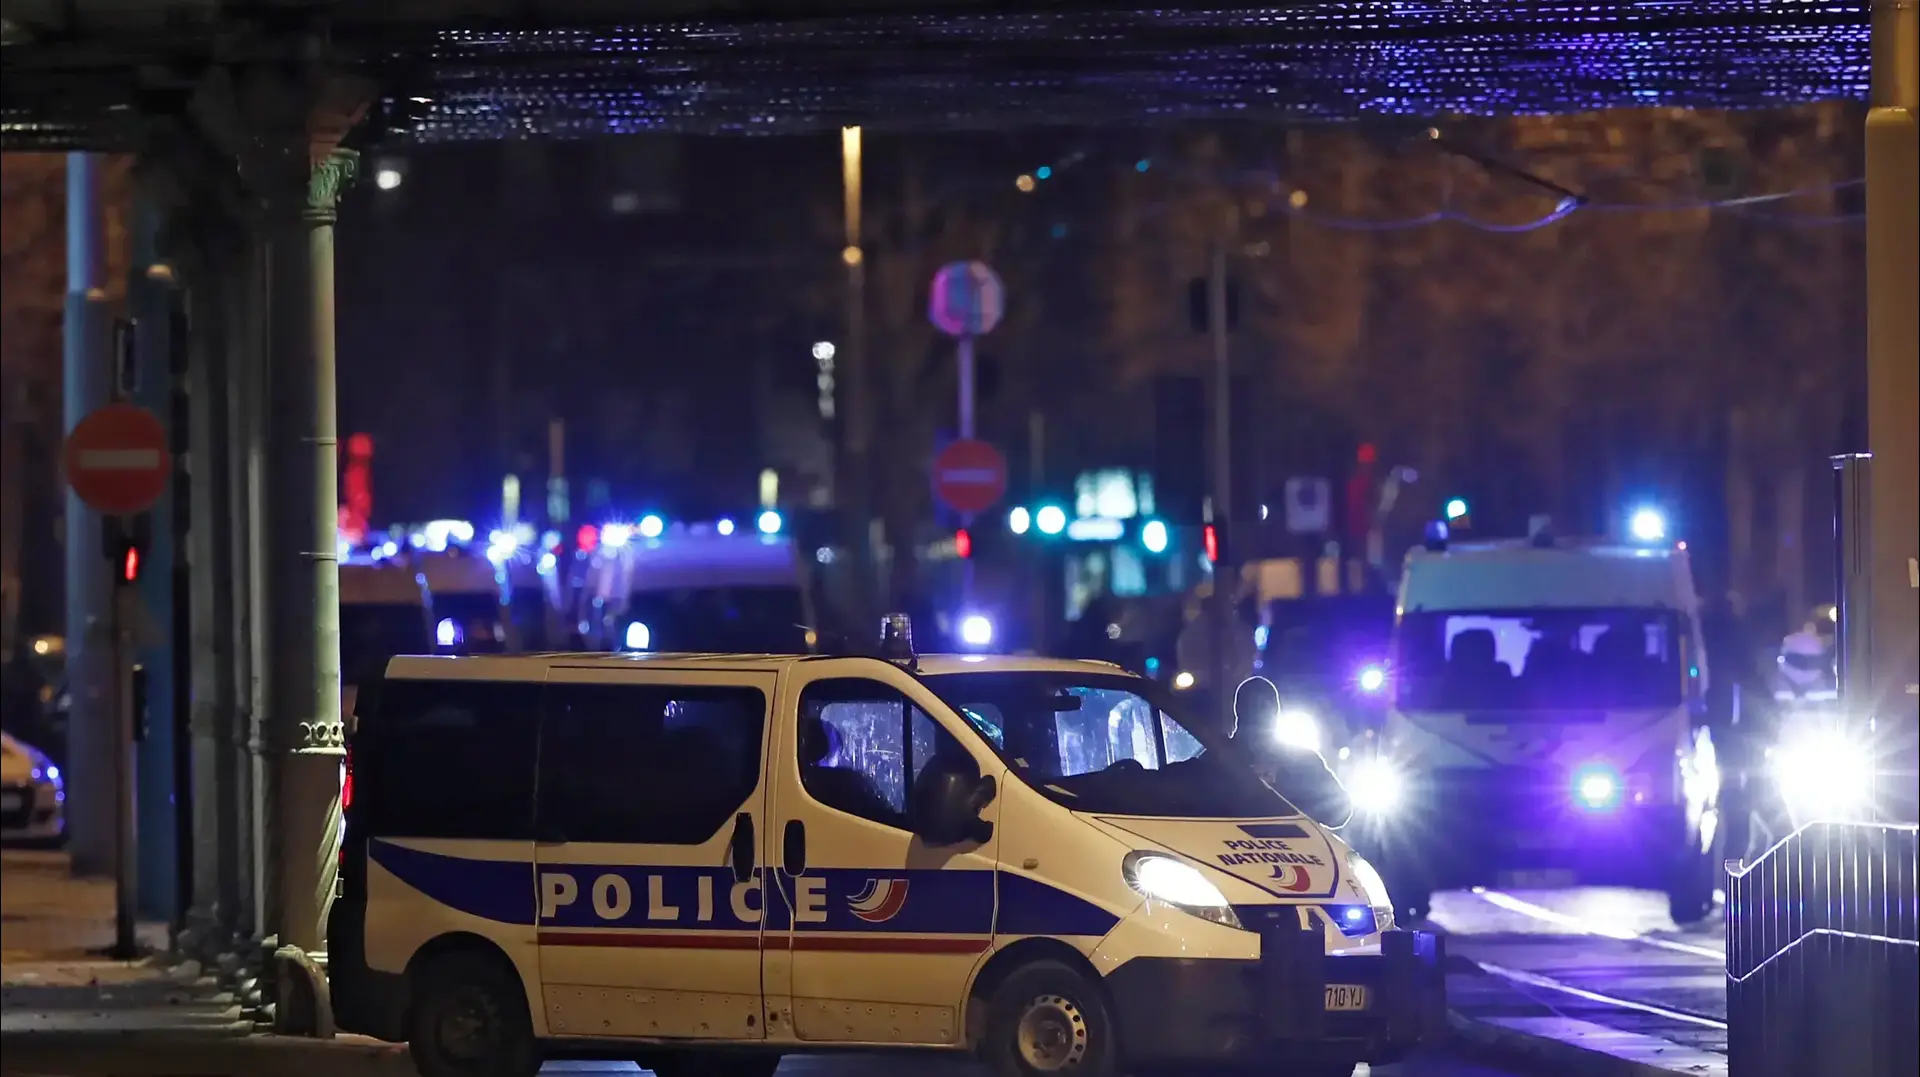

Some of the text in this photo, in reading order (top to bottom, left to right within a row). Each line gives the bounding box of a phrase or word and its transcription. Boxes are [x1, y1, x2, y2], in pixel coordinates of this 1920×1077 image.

[1223, 840, 1292, 850] POLICE
[1216, 853, 1325, 866] NATIONALE
[540, 873, 828, 923] POLICE
